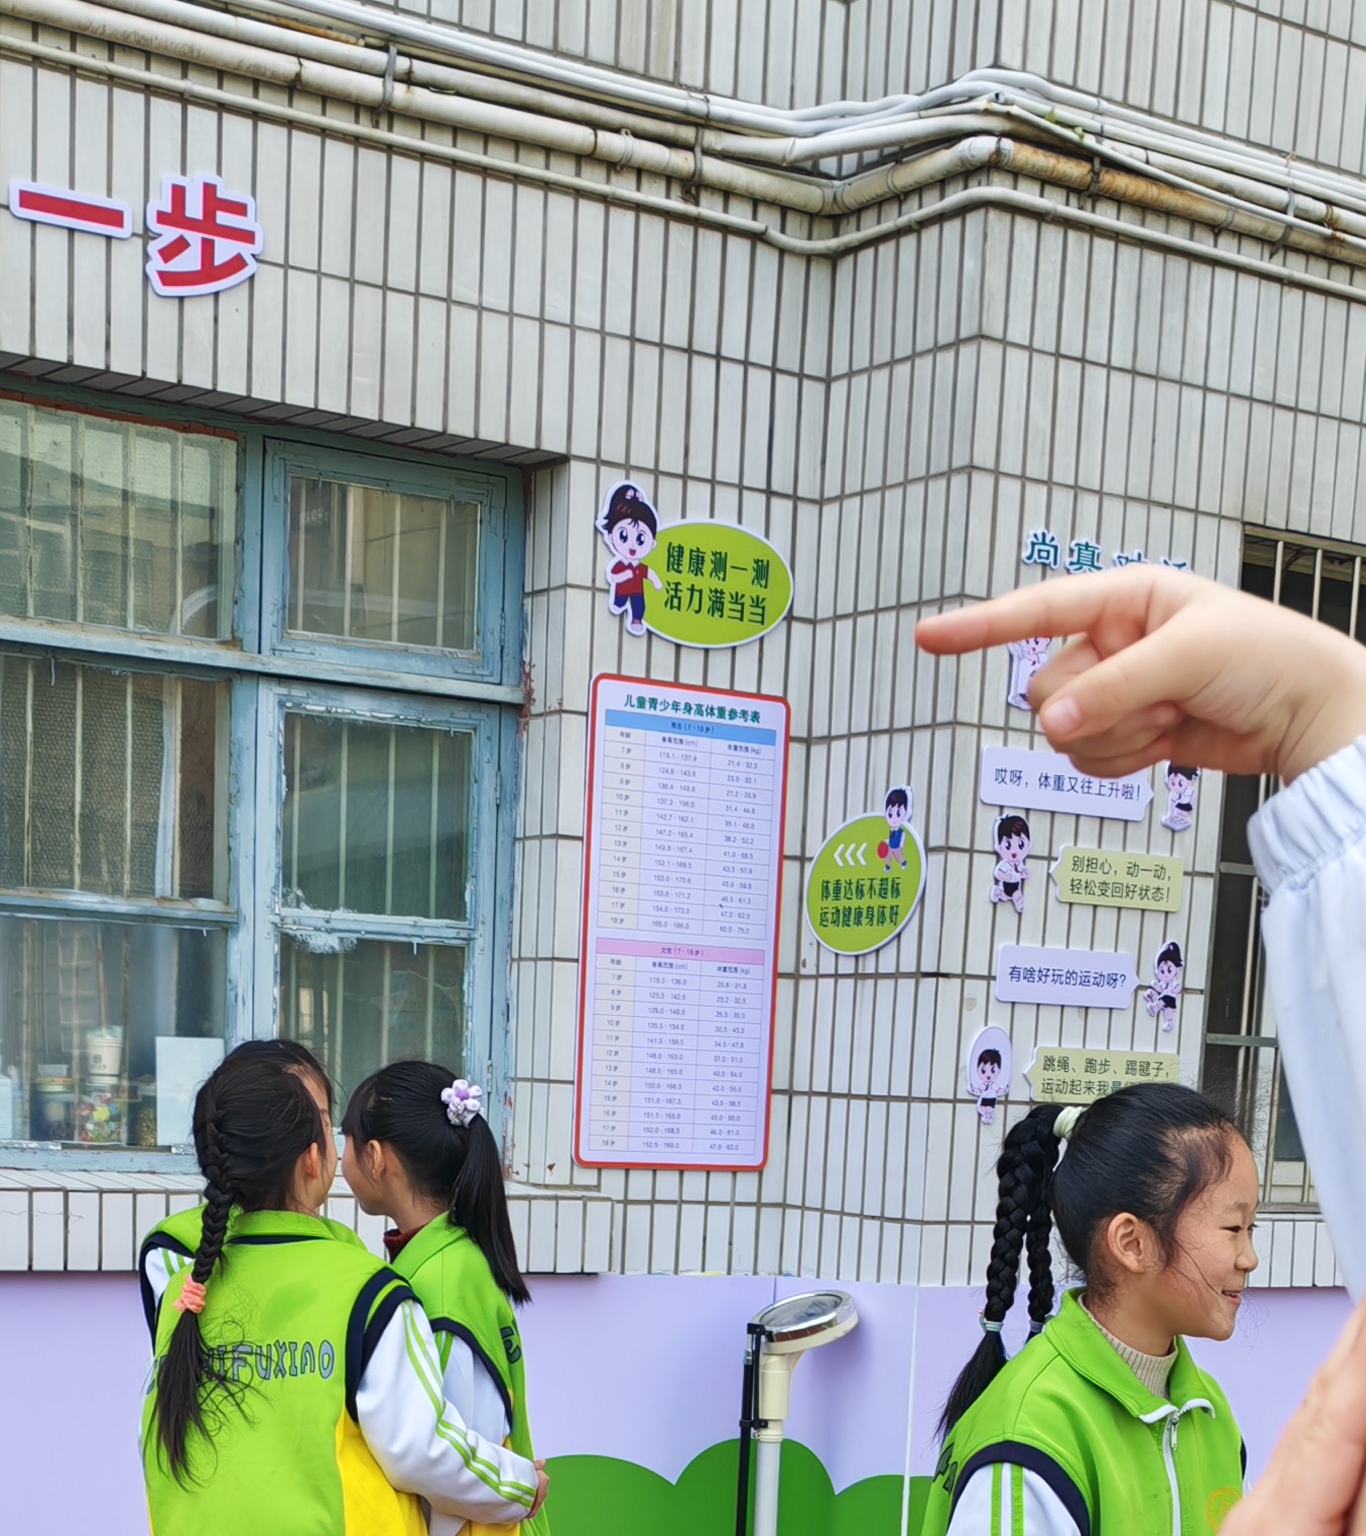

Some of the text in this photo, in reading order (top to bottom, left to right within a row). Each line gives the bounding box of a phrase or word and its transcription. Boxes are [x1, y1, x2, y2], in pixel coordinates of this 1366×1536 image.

[666, 542, 770, 590] 健康测一测
[664, 580, 766, 626] 活力满当当
[624, 694, 760, 724] 儿童青少年身高体重参考表
[821, 877, 901, 901] 体重达标不超标
[1070, 878, 1170, 902] 轻松变回好状态！
[819, 904, 900, 928] 运动健康身体好
